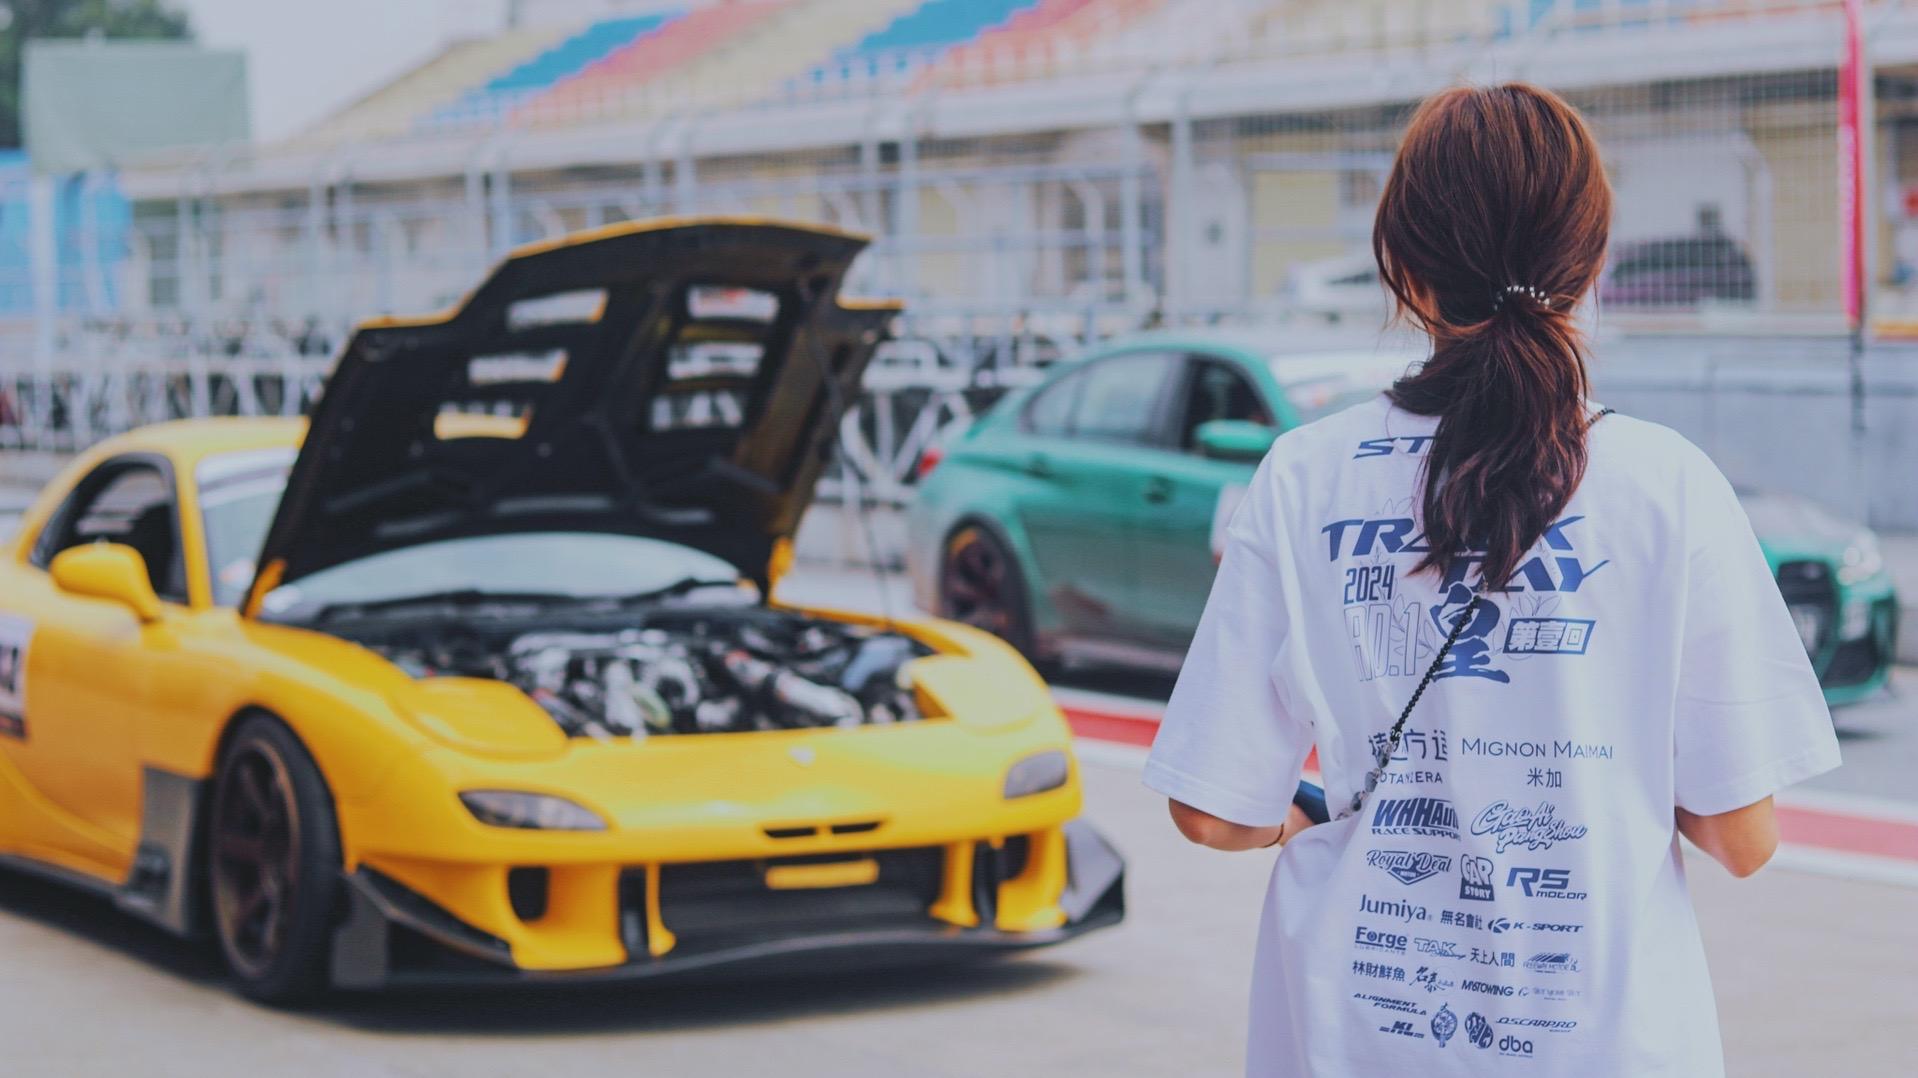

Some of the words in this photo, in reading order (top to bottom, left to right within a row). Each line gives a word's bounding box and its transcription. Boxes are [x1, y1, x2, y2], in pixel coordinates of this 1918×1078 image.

[1352, 436, 1436, 459] ST
[1344, 565, 1395, 605] 2024
[1462, 738, 1546, 757] MIGNON
[1527, 767, 1562, 788] 米加
[1412, 828, 1460, 841] SUPPO
[1366, 849, 1412, 870] Royal
[1416, 852, 1452, 873] Deal
[1461, 853, 1494, 886] CAR
[1506, 867, 1571, 897] RS
[1464, 886, 1492, 899] STORY
[1355, 926, 1408, 950] Forge
[1470, 947, 1515, 967] 天上人間
[1354, 992, 1418, 1007] ALIGNMENT
[1373, 1002, 1427, 1016] FORMULA
[1498, 1035, 1533, 1054] dba
